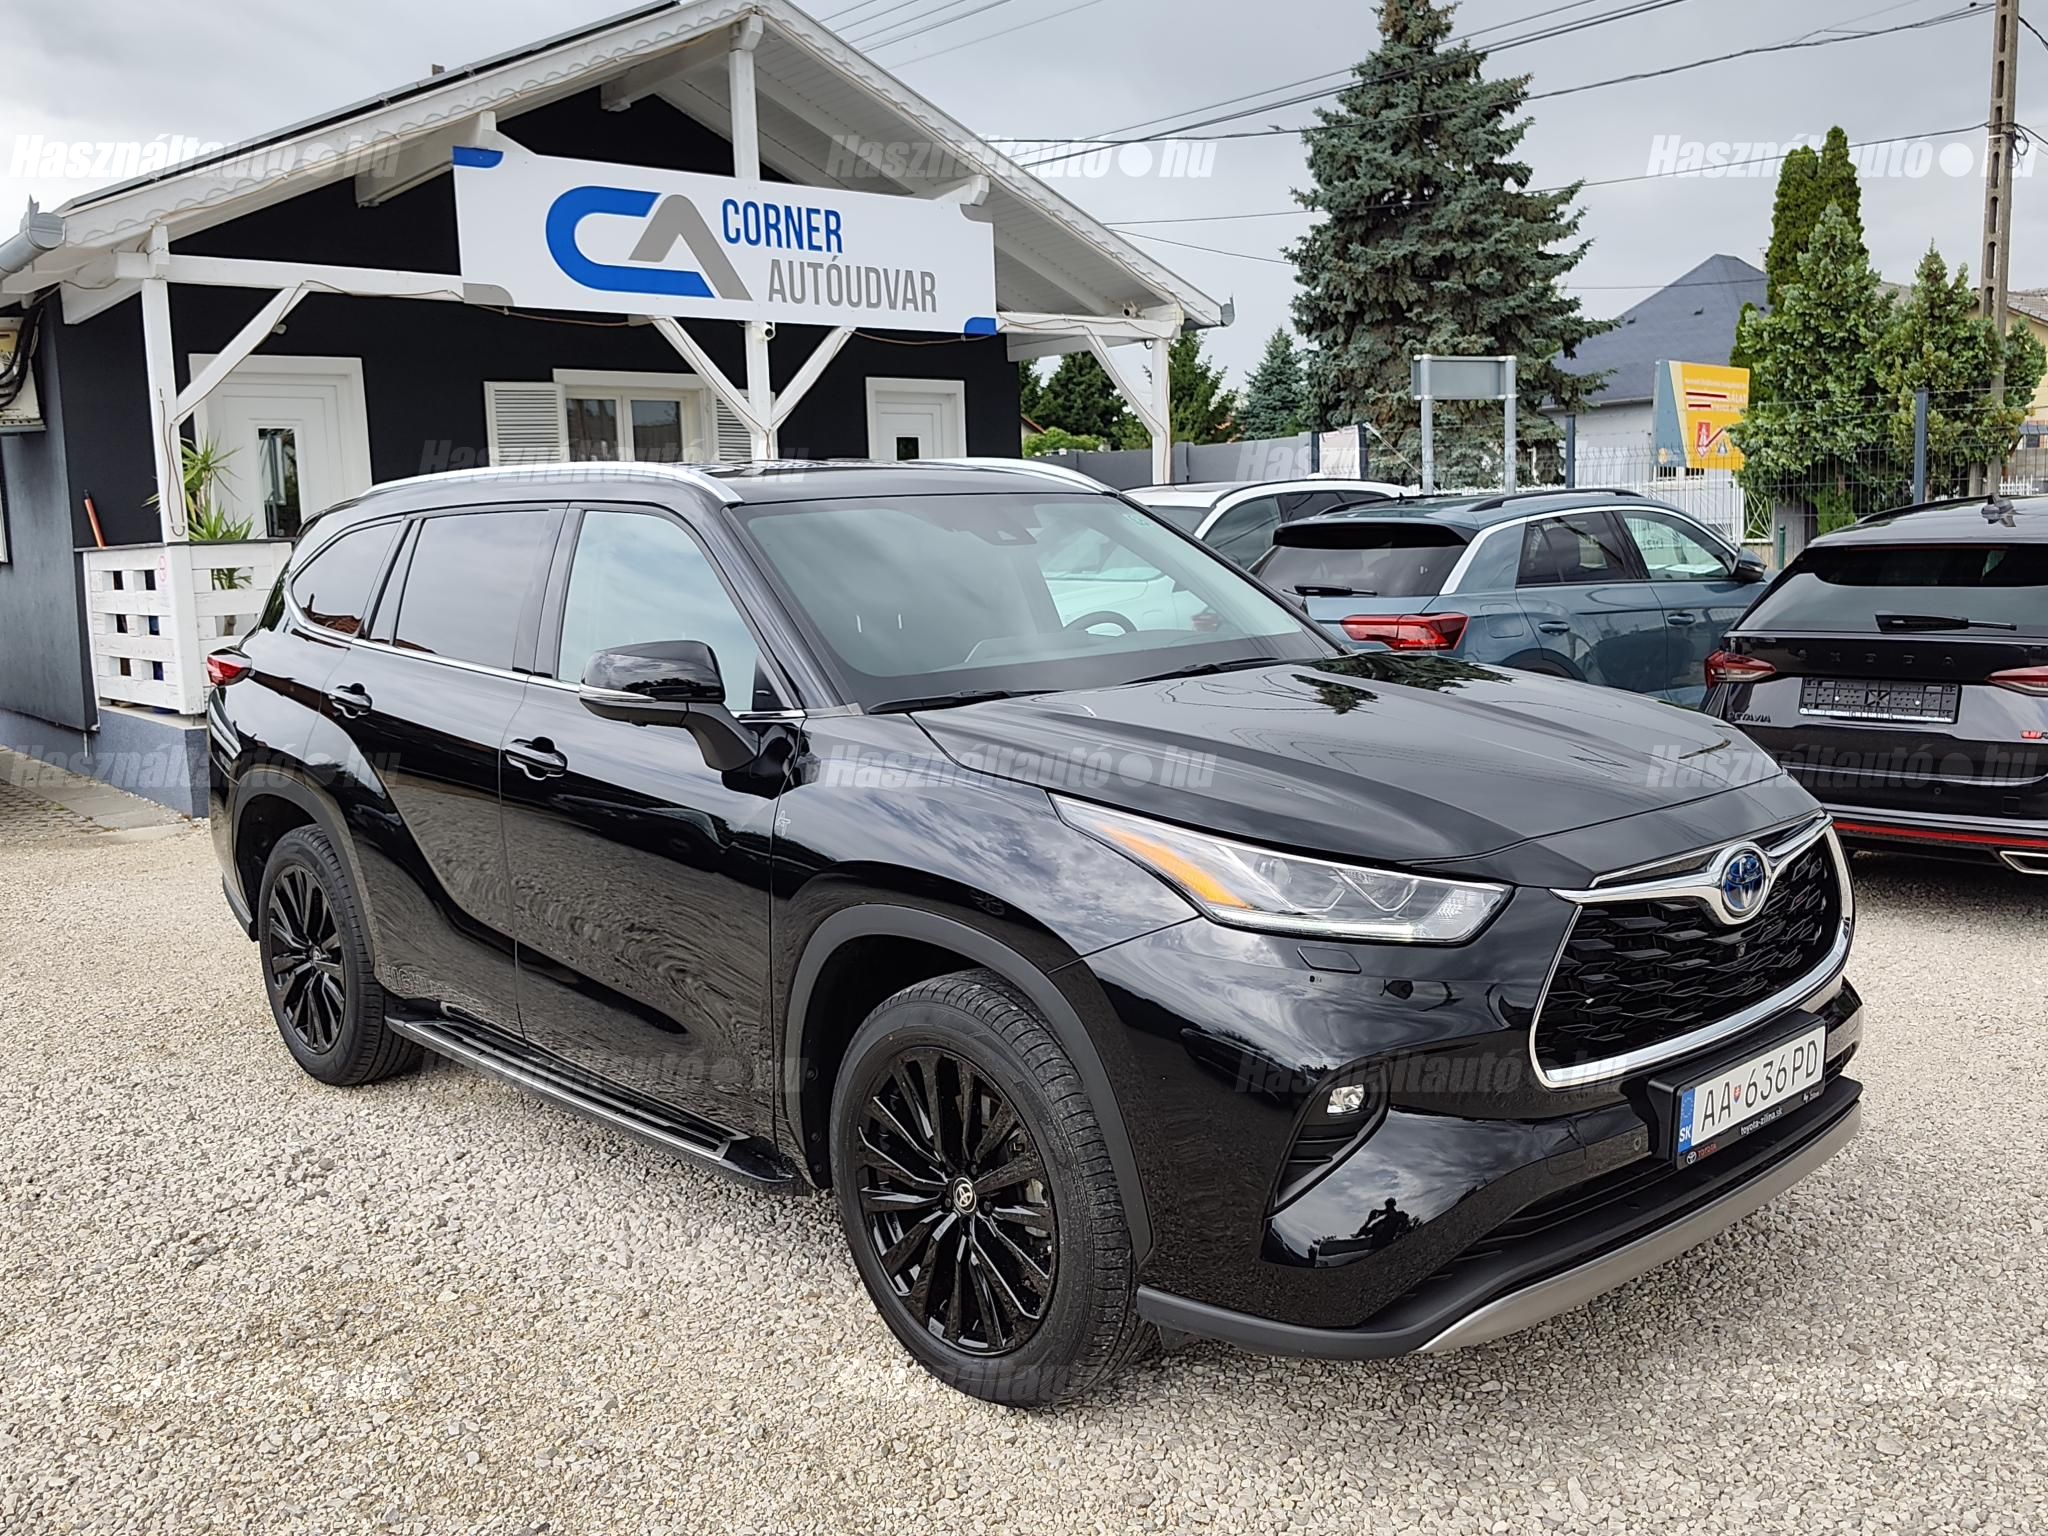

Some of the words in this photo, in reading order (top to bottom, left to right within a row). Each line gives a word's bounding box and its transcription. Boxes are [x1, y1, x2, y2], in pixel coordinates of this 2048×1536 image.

[721, 198, 843, 254] CORNER
[767, 255, 938, 313] AUTÓUDVAR
[1702, 1081, 1731, 1132] AA
[1745, 1040, 1818, 1109] 636PD
[1679, 1127, 1691, 1142] SK
[1740, 1106, 1783, 1136] toyota-zilina.sk
